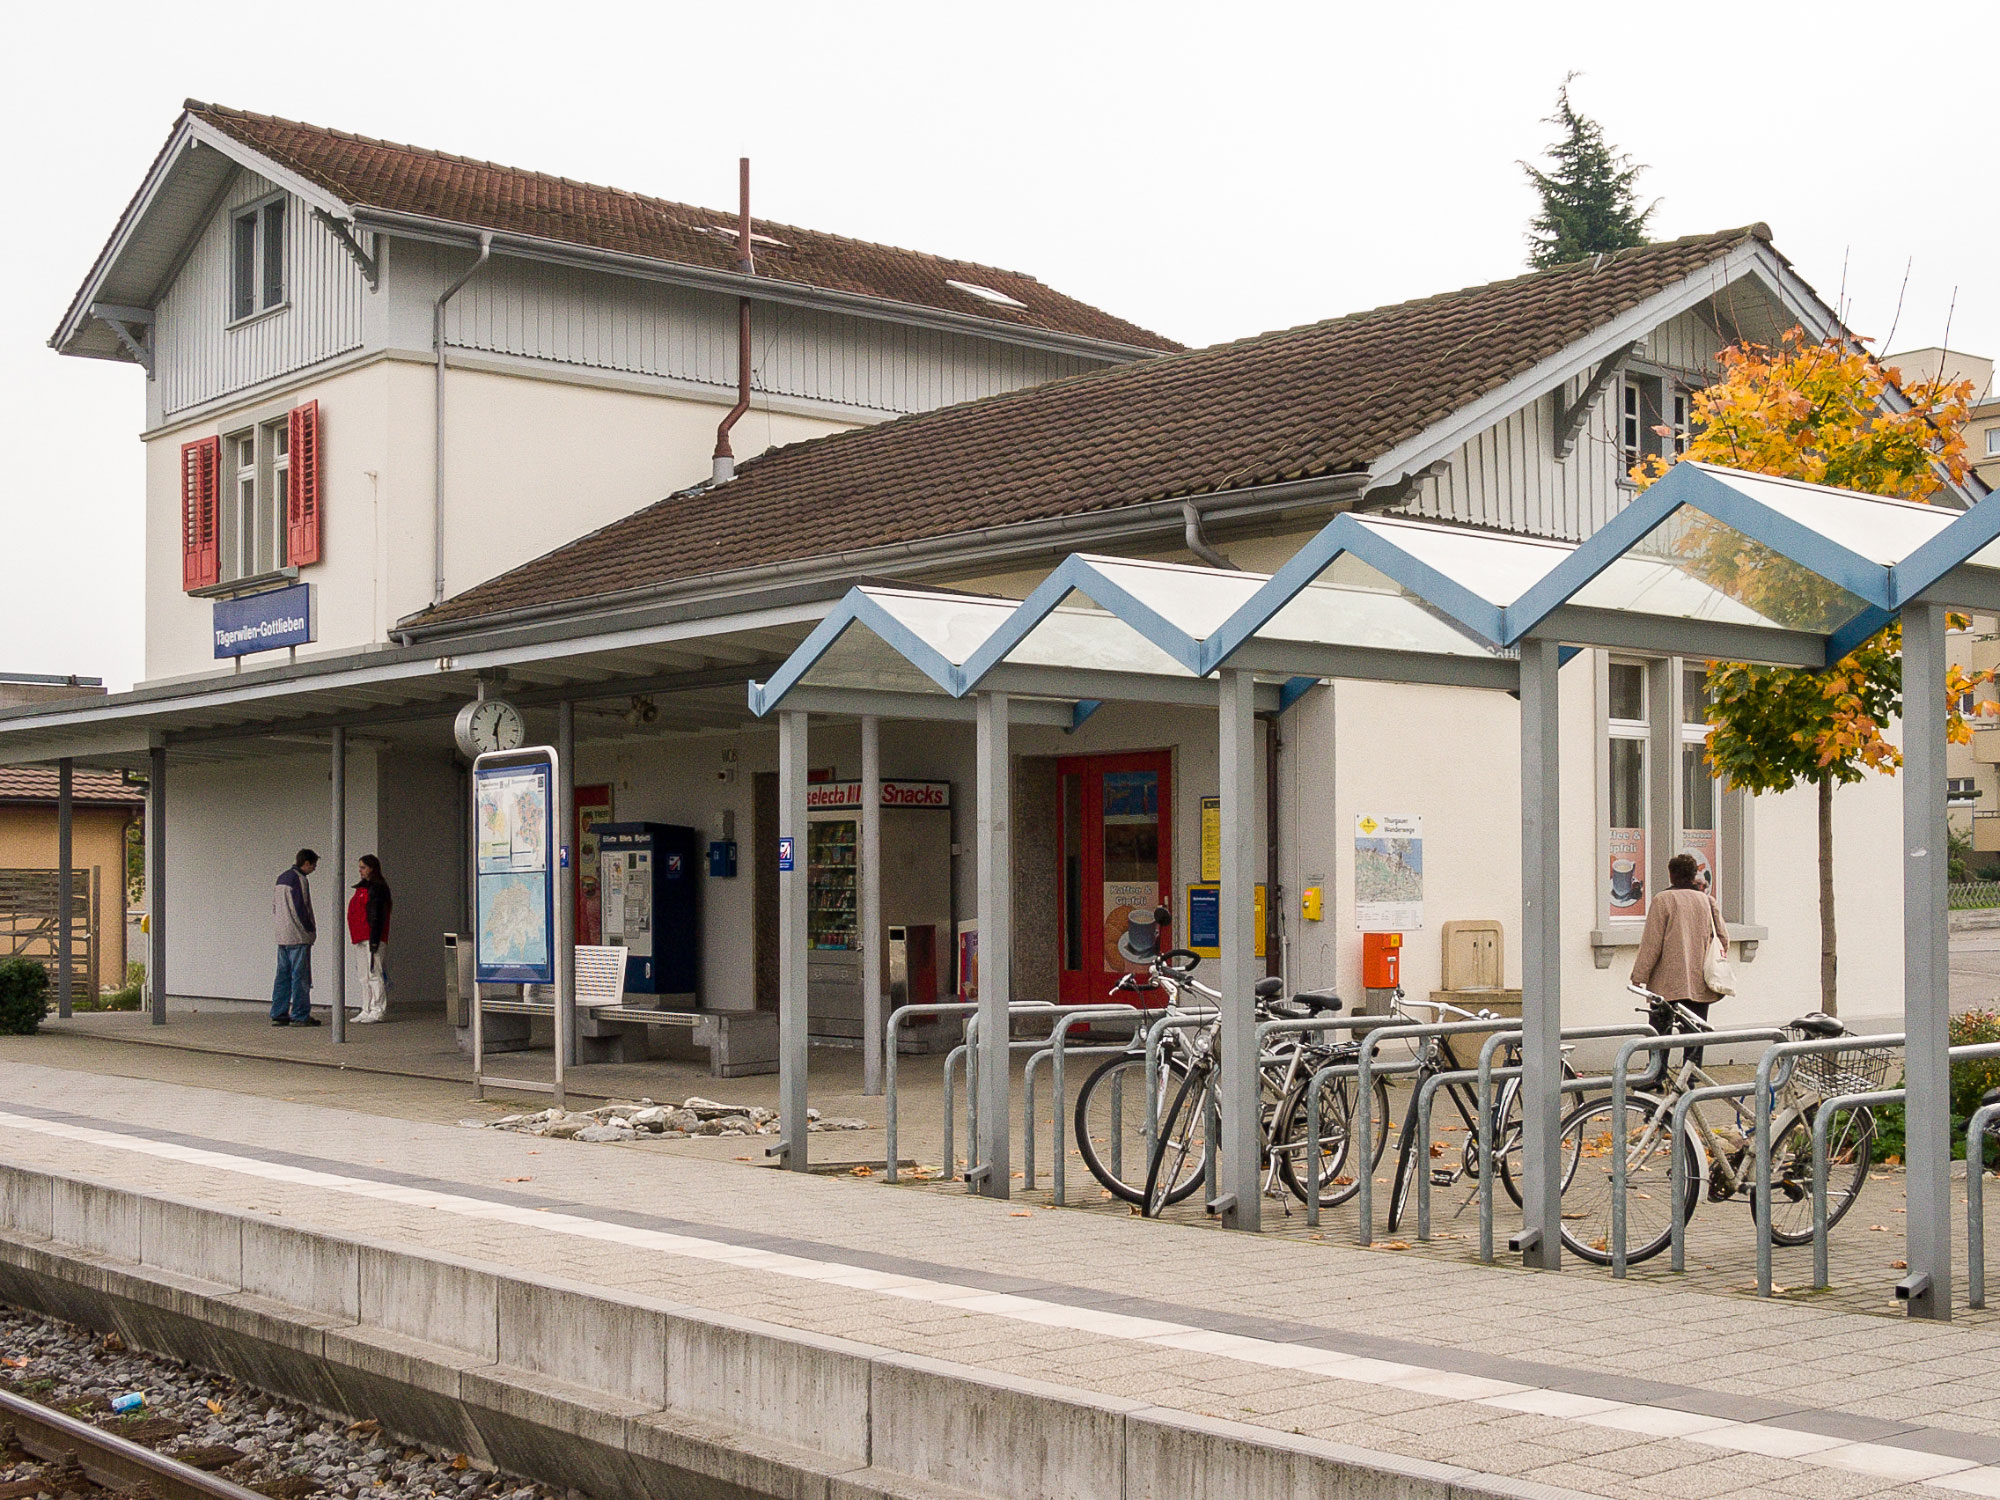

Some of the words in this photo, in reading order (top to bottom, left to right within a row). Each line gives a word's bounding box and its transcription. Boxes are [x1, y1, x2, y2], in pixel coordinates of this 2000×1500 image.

[215, 616, 305, 648] Tägerwilen-Gottlieben
[881, 783, 944, 804] Snacks
[1632, 830, 1641, 840] &
[1144, 885, 1152, 895] &
[1115, 896, 1147, 906] Gipfeli
